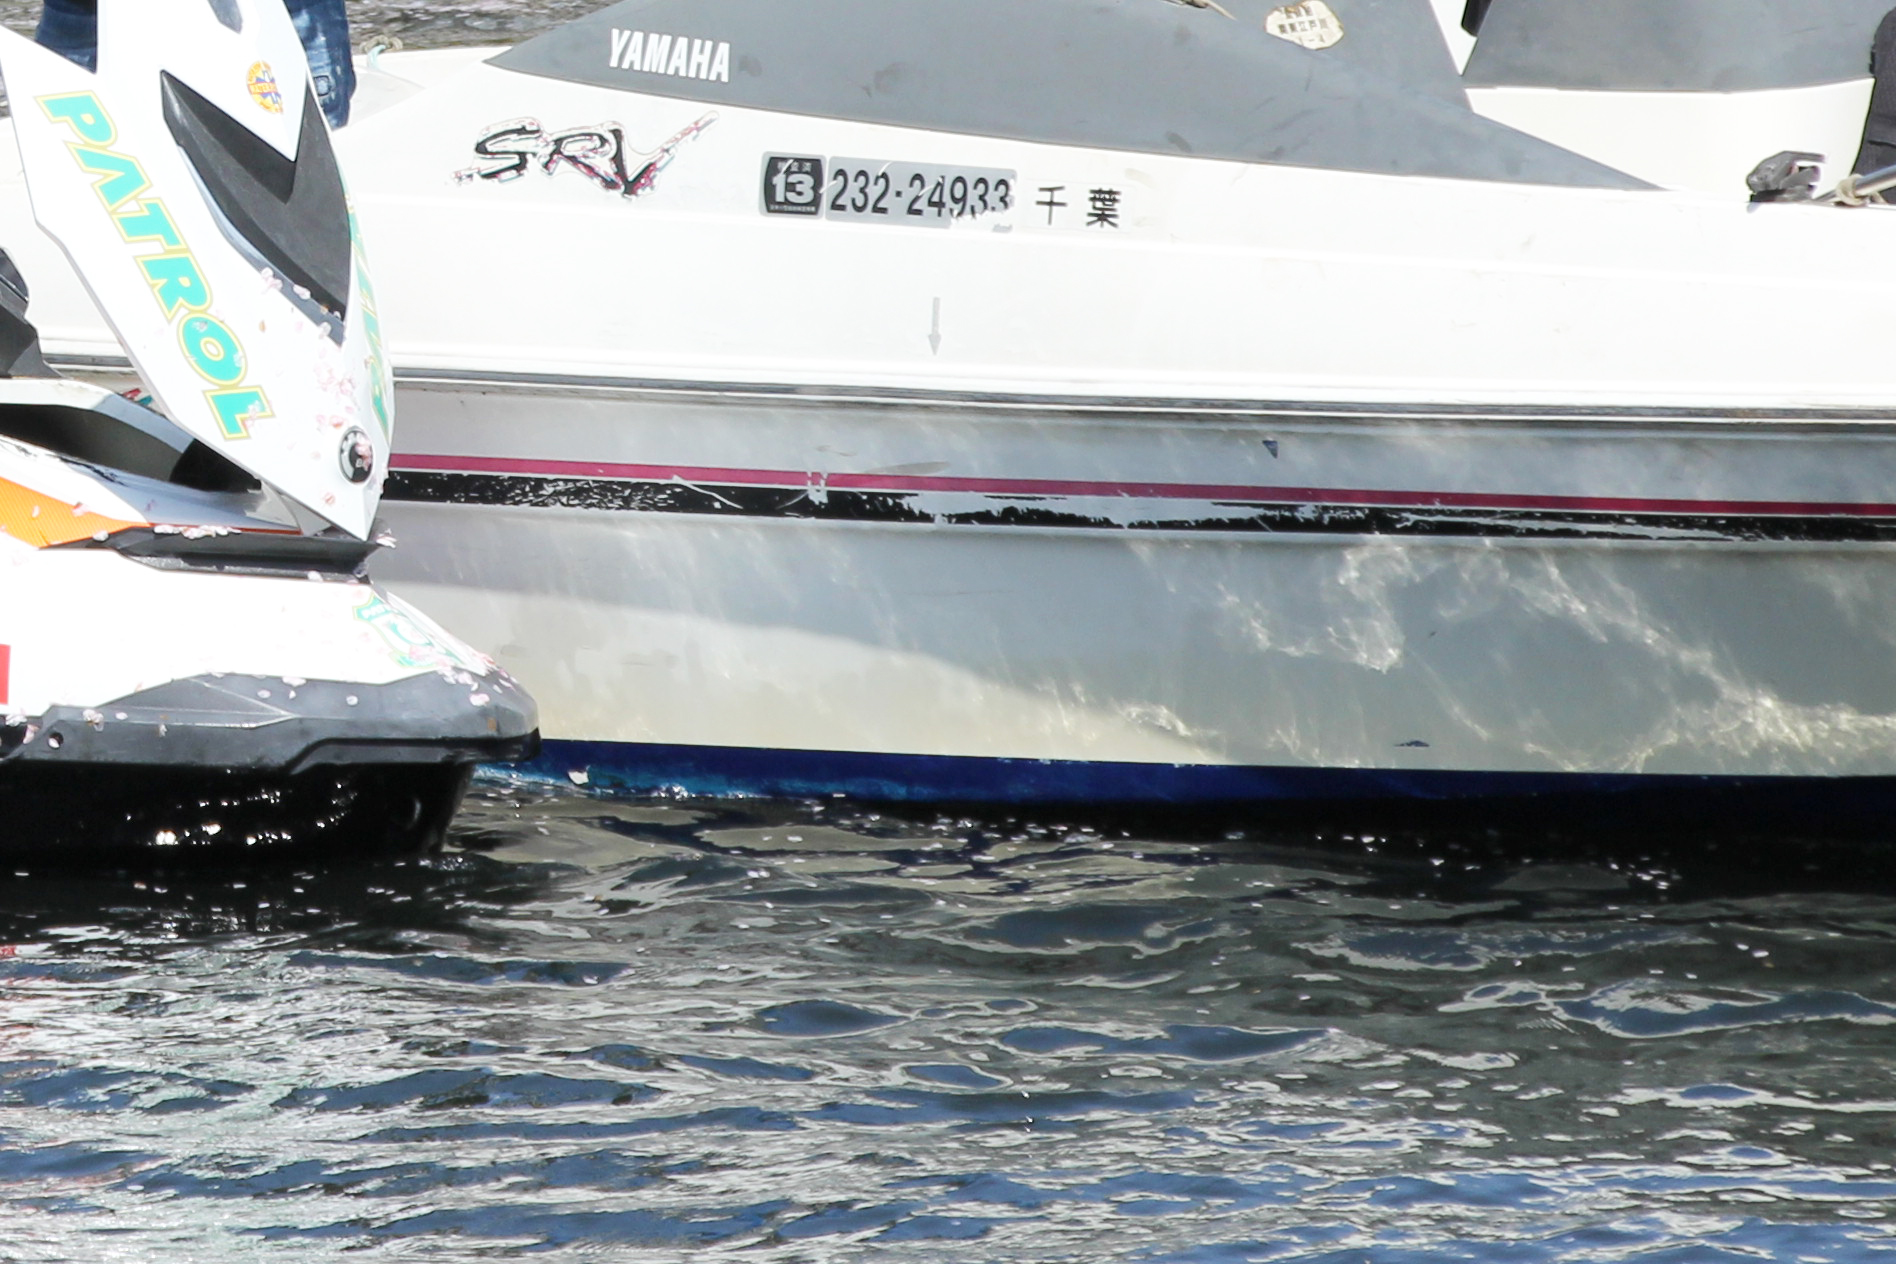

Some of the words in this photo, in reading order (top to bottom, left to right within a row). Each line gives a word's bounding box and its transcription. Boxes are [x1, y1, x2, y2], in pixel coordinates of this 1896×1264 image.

[609, 28, 731, 83] YAMAHA
[450, 111, 719, 201] SRV
[772, 173, 815, 204] 13
[1035, 185, 1122, 228] 千葉
[33, 89, 276, 441] PATROL
